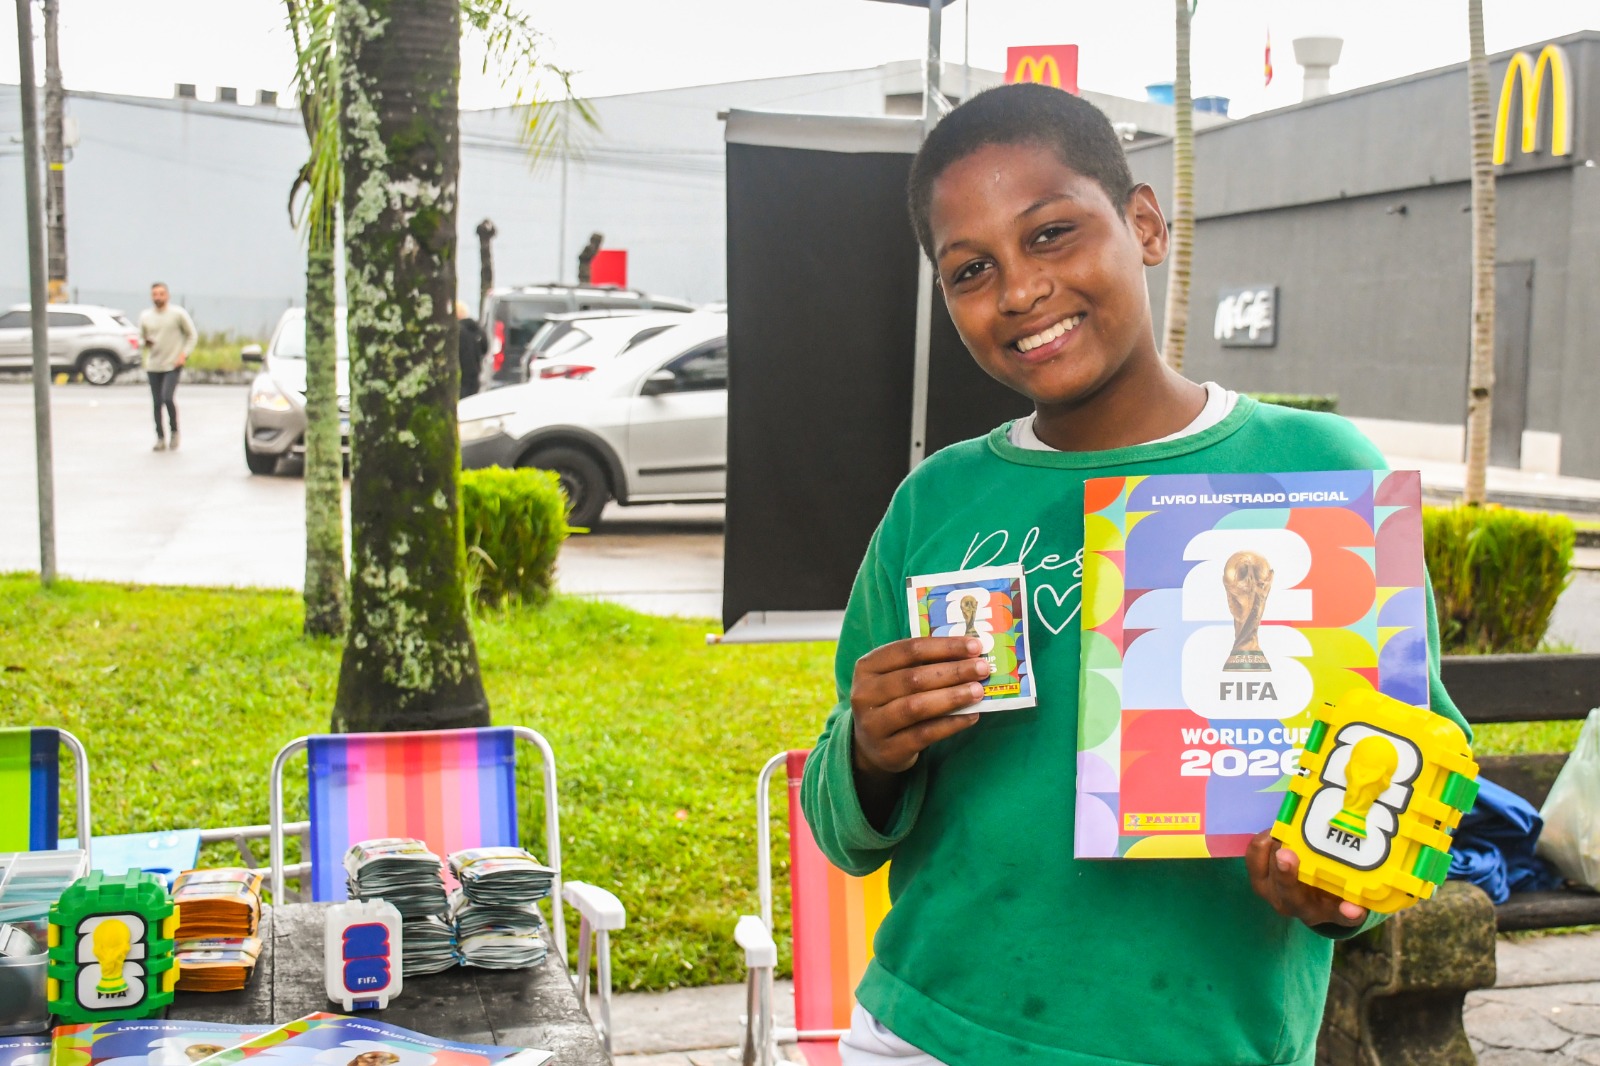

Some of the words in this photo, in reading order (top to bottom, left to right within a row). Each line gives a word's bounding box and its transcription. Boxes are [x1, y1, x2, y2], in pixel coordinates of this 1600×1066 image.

[1151, 495, 1197, 506] LIVRO
[1199, 493, 1286, 505] ILUSTRADO
[1288, 490, 1349, 503] OFICIAL
[1219, 681, 1279, 701] FIFA
[1180, 727, 1265, 745] WORLD
[1180, 748, 1312, 776] 2026
[1145, 815, 1197, 824] PANINI
[1326, 826, 1362, 851] FIFA
[357, 976, 378, 985] FIFA
[345, 1022, 380, 1033] LIVRO
[380, 1030, 445, 1049] ILUSTRADO
